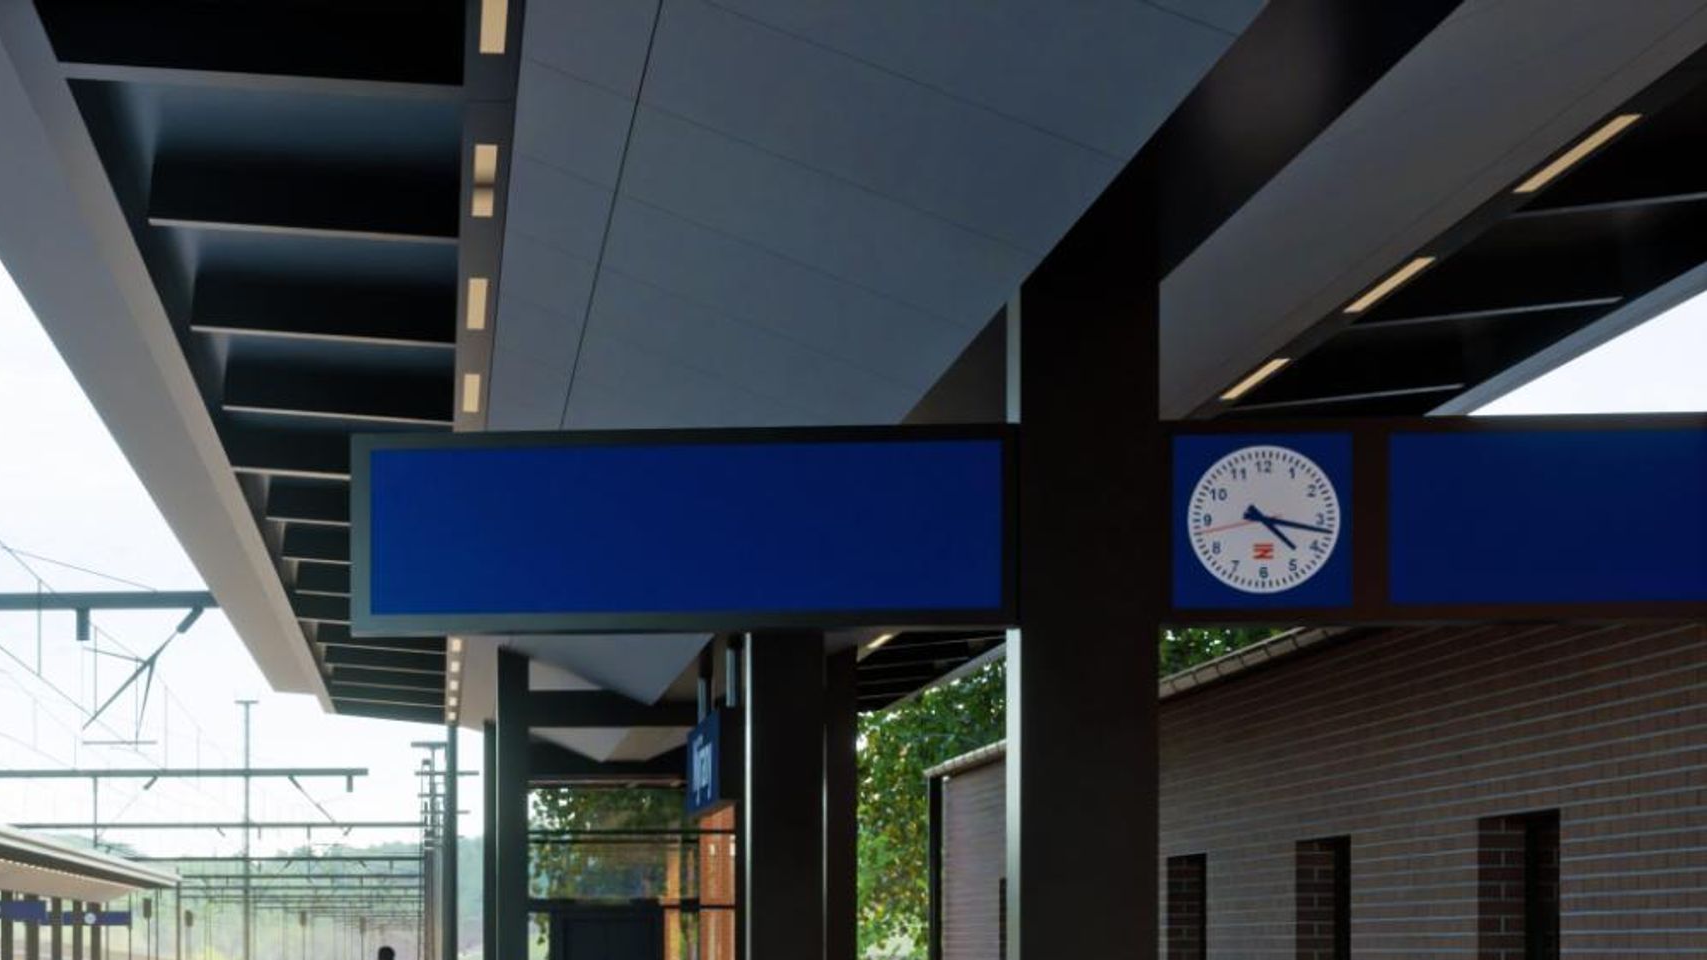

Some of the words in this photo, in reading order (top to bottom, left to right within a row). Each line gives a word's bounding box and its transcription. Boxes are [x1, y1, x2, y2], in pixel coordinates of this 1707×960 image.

[1256, 461, 1272, 473] 12
[1289, 468, 1295, 478] 1
[1232, 469, 1247, 479] 11
[1211, 489, 1227, 501] 10
[1307, 485, 1316, 497] 2
[1203, 514, 1212, 526] 9
[1316, 513, 1325, 525] 3
[1212, 541, 1221, 554] 8
[1310, 540, 1319, 551] 4
[1231, 560, 1239, 573] 7
[1289, 559, 1297, 571] 5
[1259, 567, 1268, 578] 6
